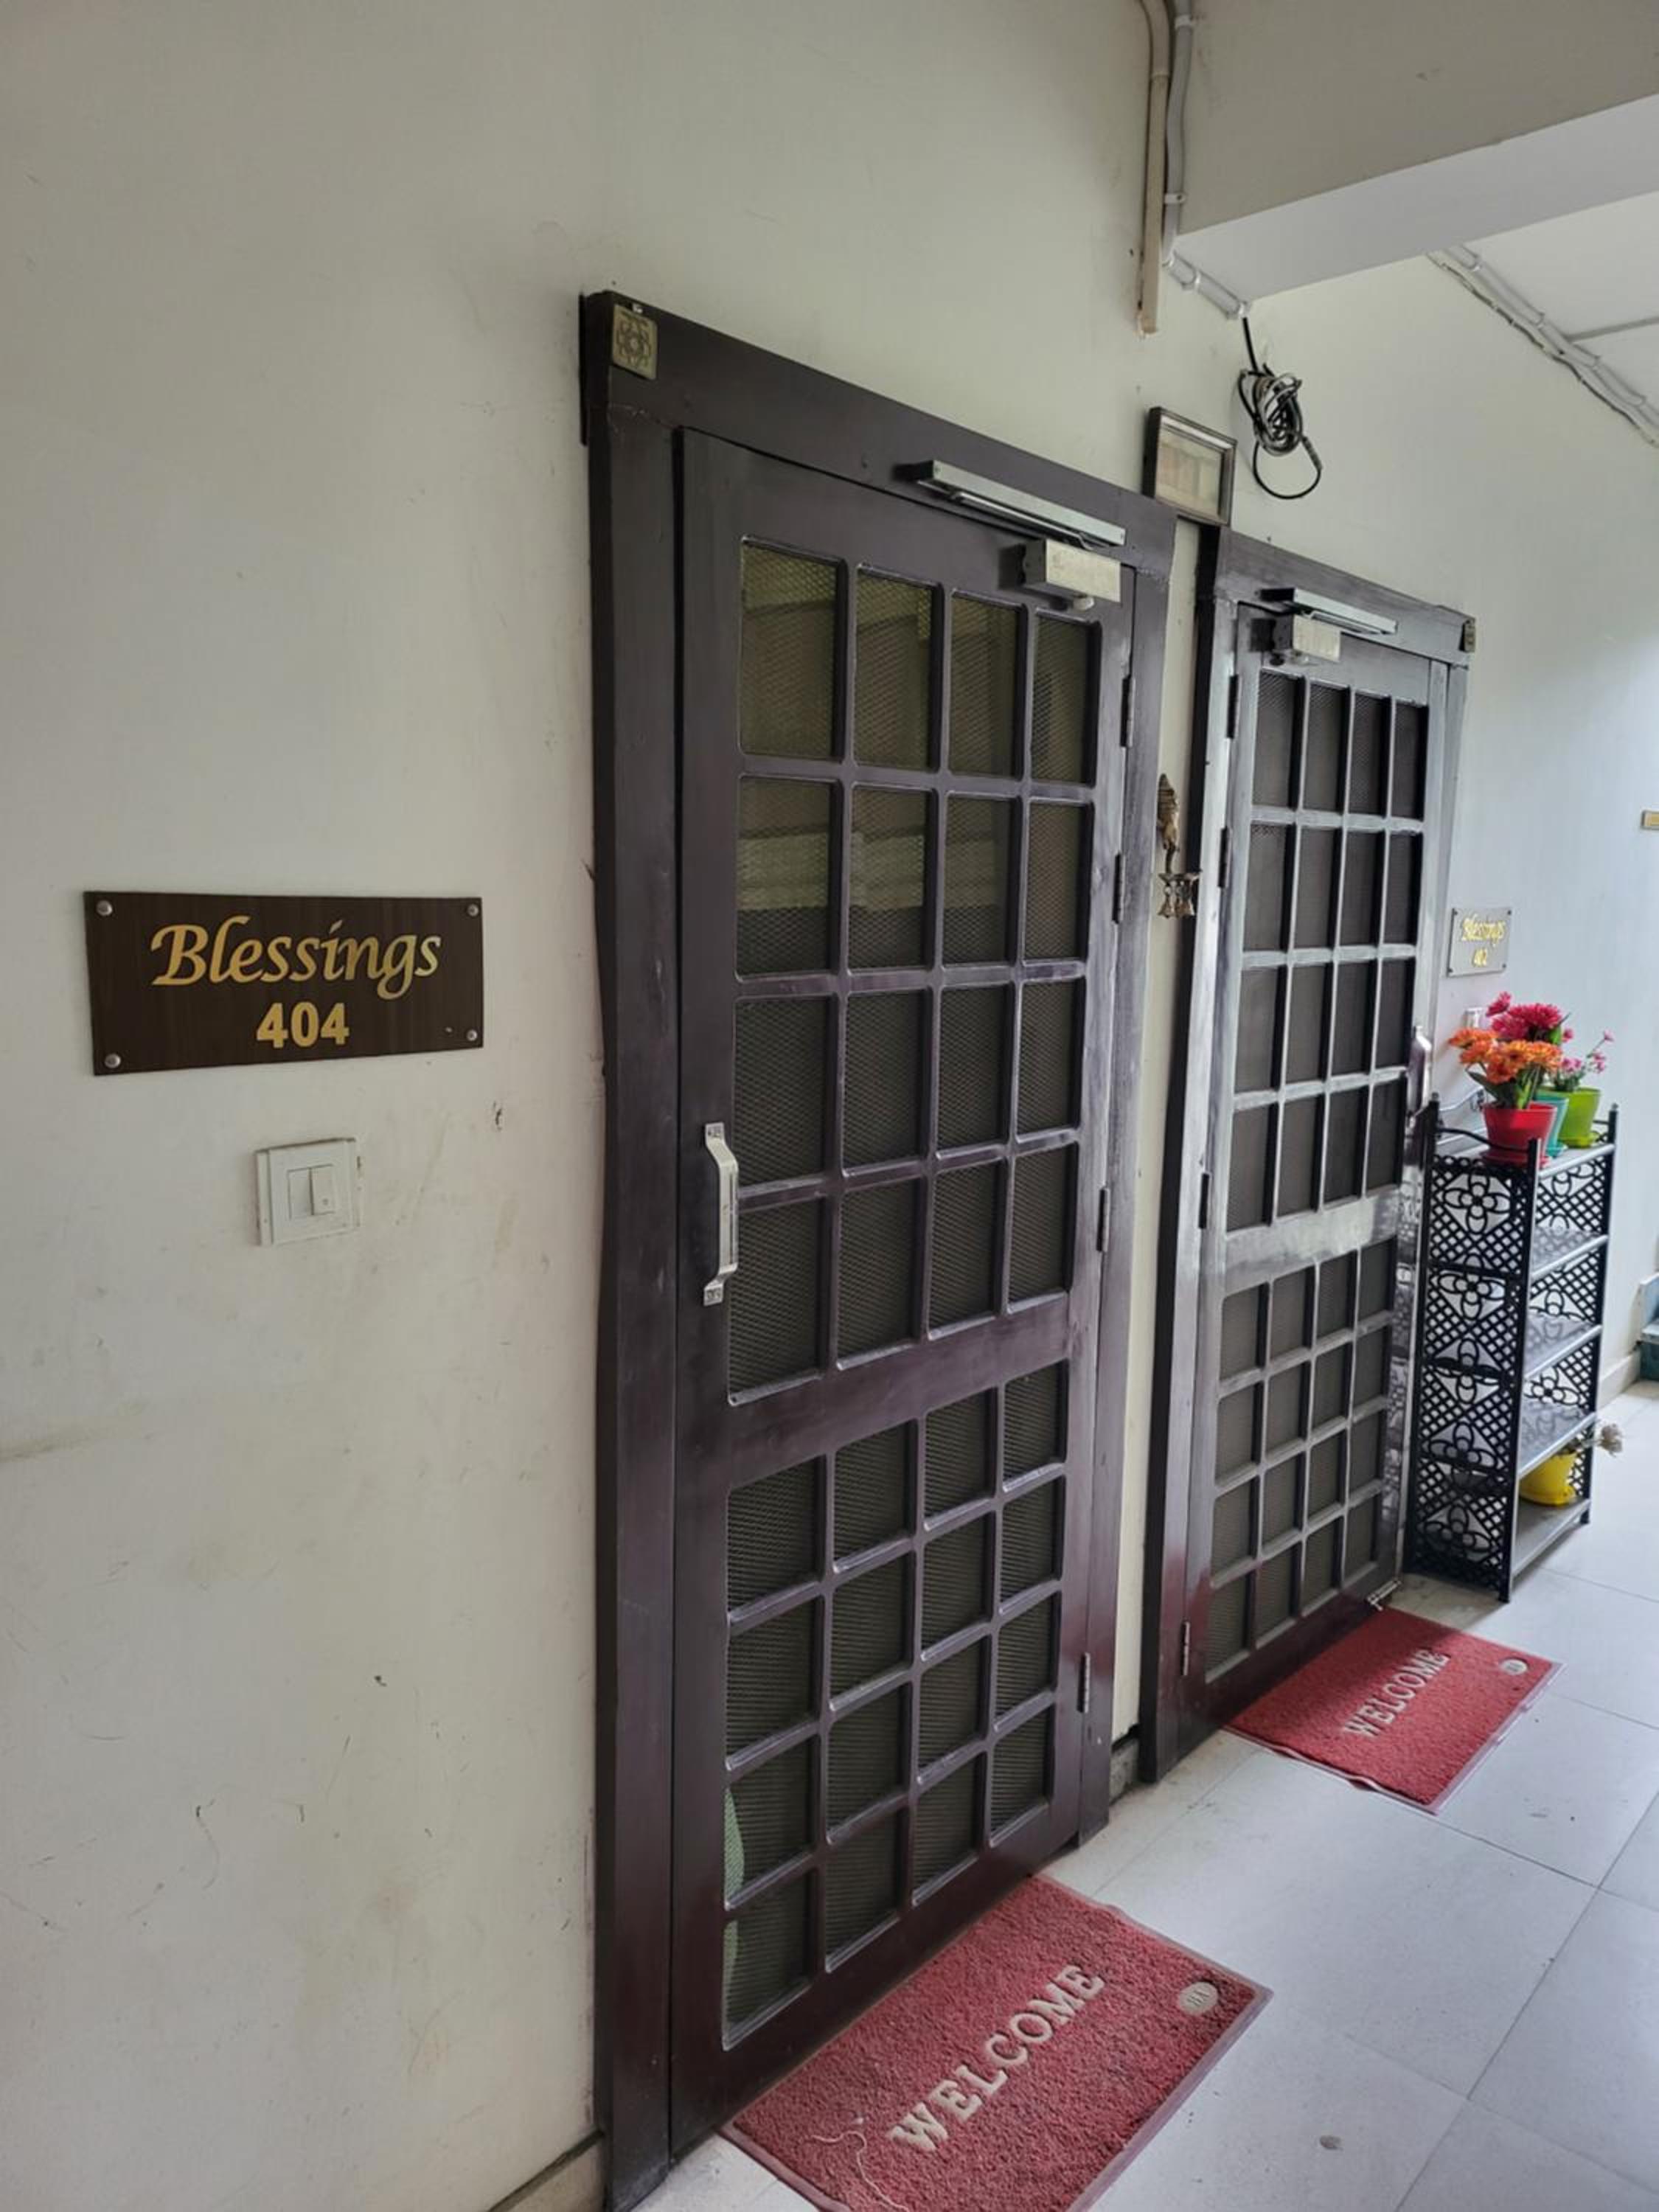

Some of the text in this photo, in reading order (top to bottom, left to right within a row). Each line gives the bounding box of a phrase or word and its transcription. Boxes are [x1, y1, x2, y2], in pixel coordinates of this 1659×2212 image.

[150, 916, 441, 1000] Blessings
[257, 1002, 350, 1048] 404
[1343, 1649, 1451, 1737] WELCOME
[890, 1965, 1105, 2152] WELCOME
